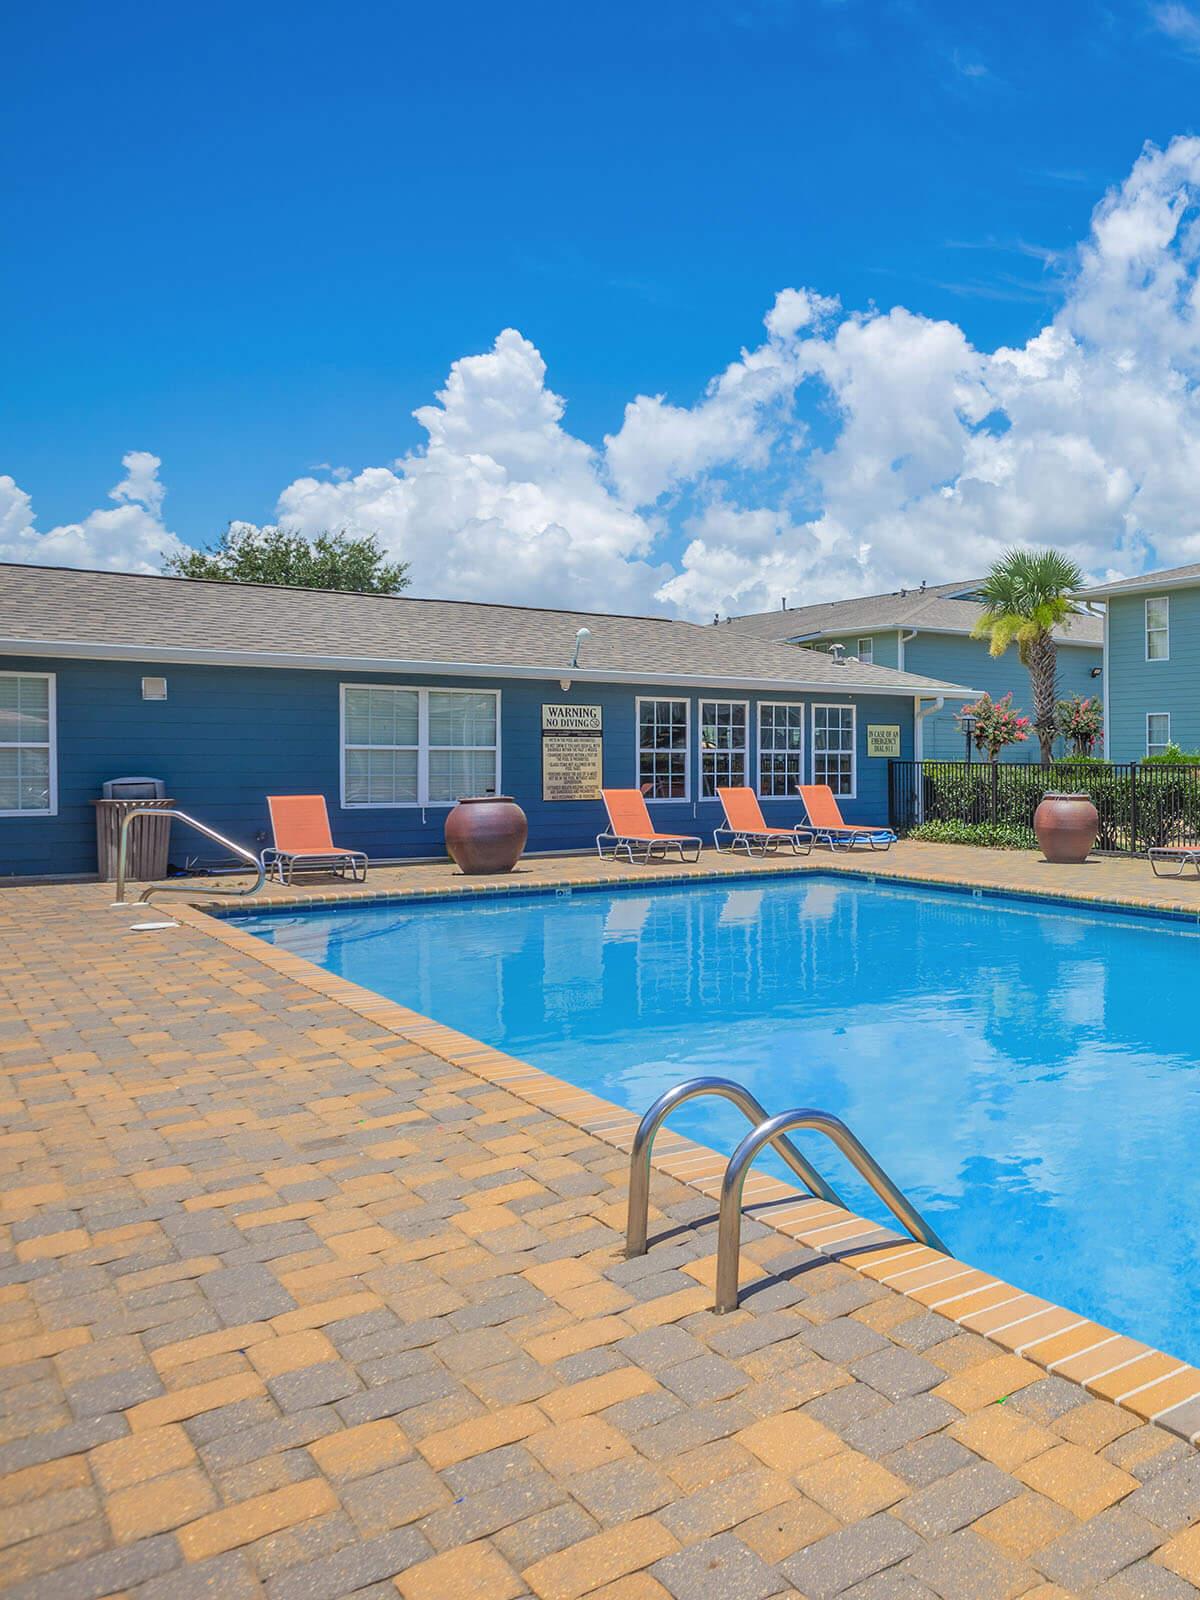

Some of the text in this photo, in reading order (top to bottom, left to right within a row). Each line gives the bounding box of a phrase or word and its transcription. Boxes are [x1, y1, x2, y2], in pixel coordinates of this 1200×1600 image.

[548, 707, 597, 718] WARNING
[546, 719, 589, 728] NO DIVING
